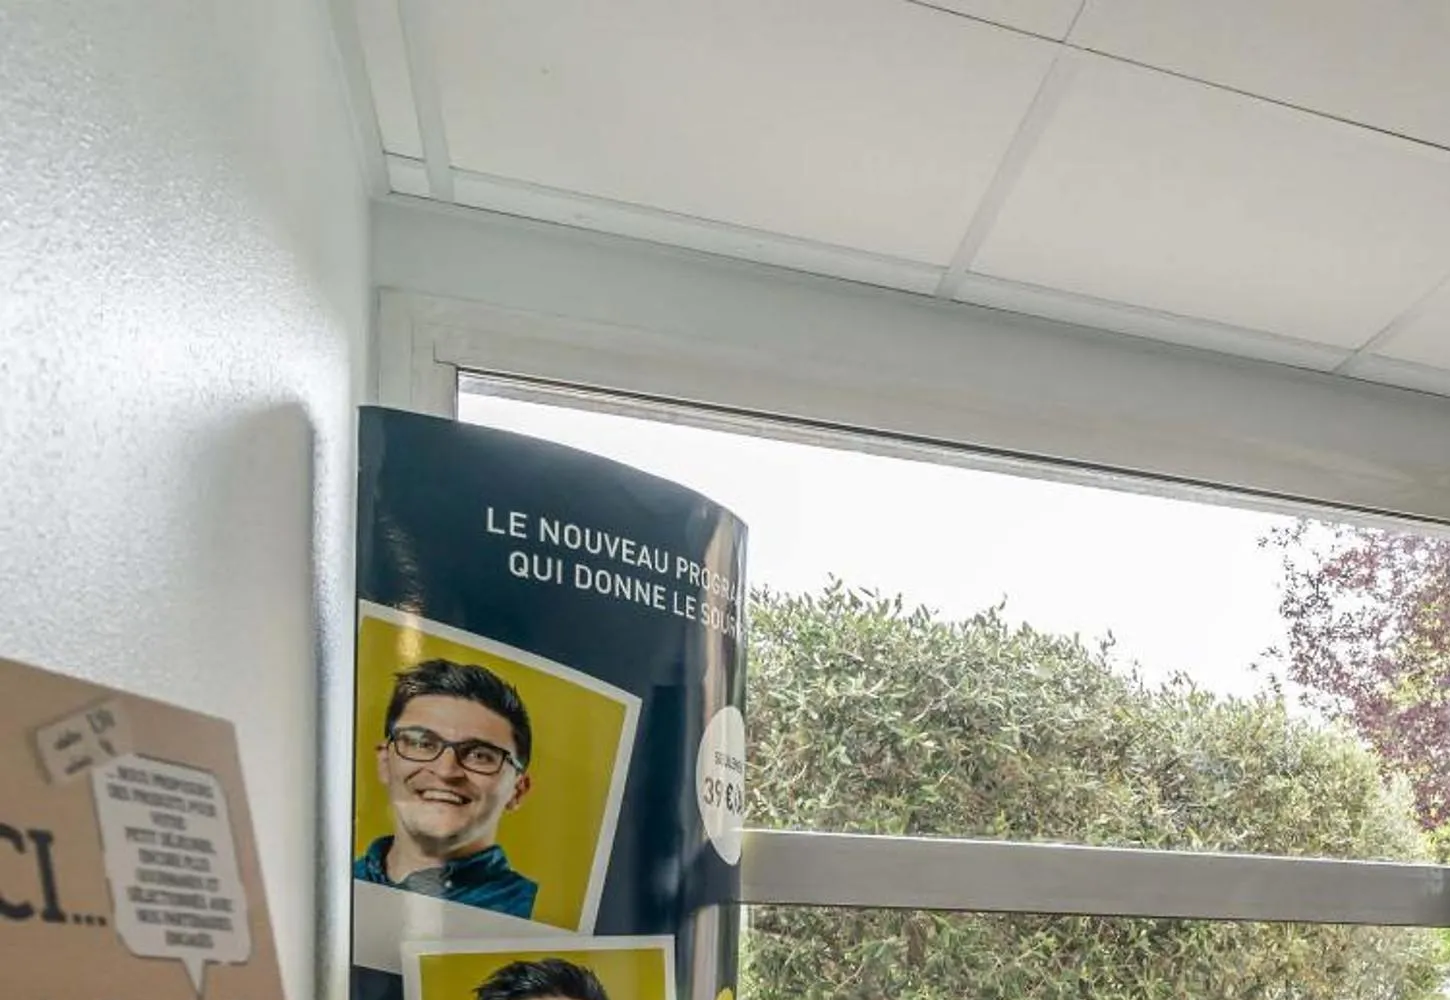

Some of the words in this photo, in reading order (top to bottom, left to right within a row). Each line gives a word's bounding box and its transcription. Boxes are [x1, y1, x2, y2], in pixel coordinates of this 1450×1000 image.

[486, 507, 528, 538] LE
[539, 517, 669, 573] NOUVEAU
[510, 550, 563, 585] QUI
[575, 563, 667, 610] DONNE
[674, 591, 697, 620] LE
